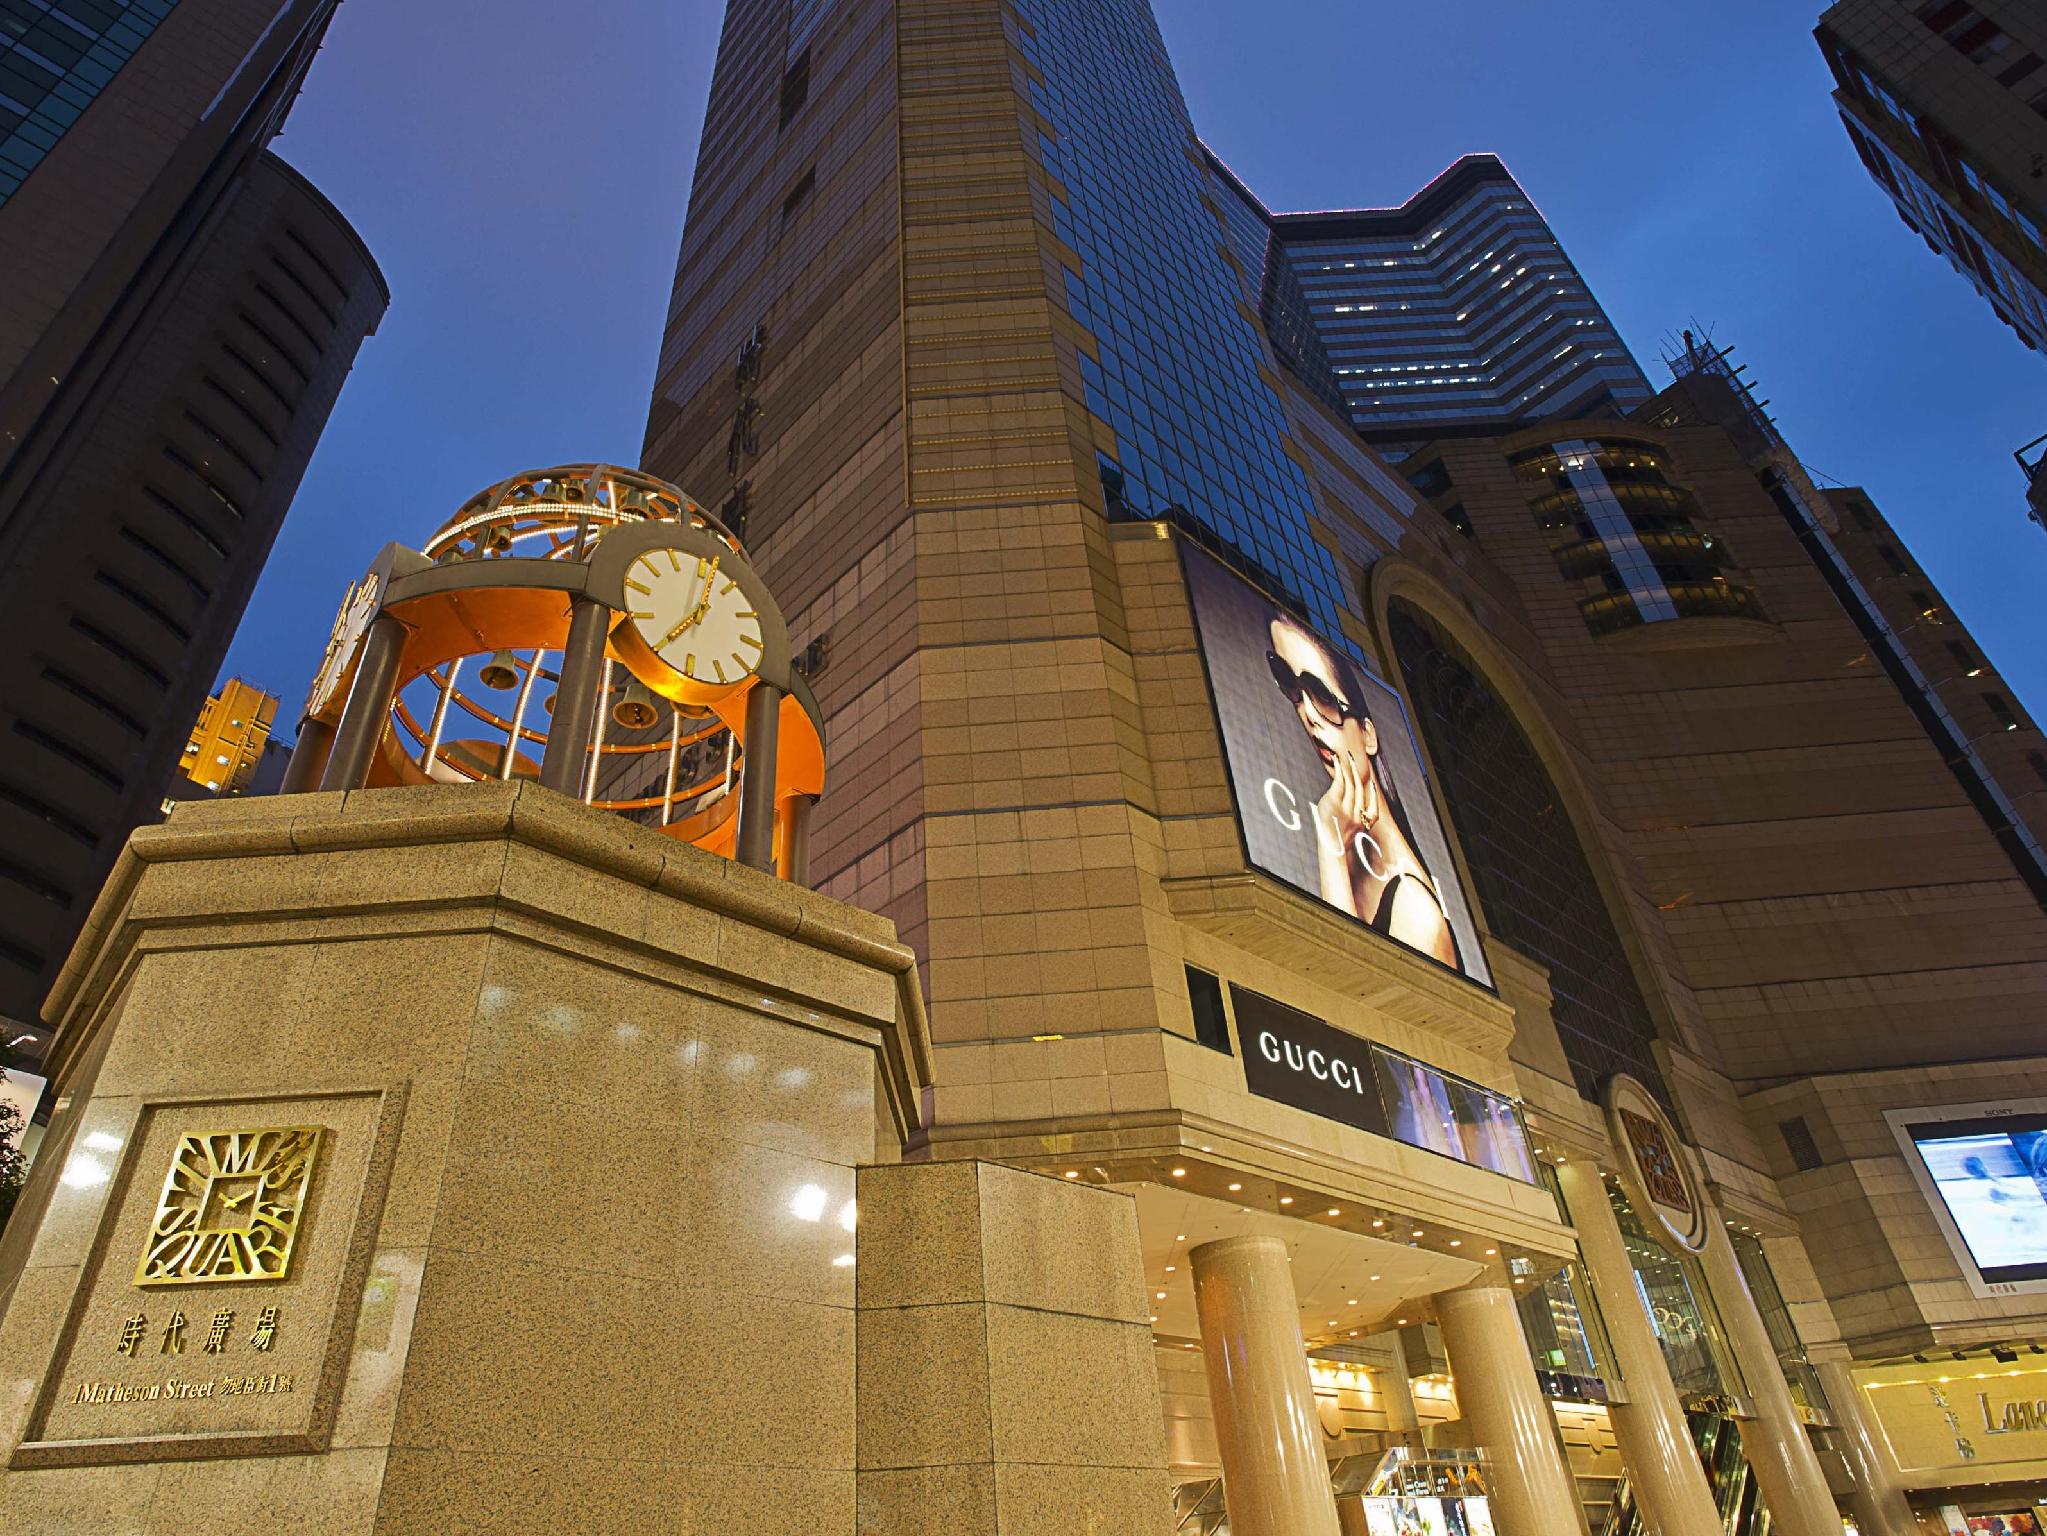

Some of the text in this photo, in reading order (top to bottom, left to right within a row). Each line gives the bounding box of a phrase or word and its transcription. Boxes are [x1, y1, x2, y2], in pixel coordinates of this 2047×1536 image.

[1260, 1031, 1364, 1094] GUCCI
[117, 1307, 277, 1357] 時代廣場
[163, 1378, 215, 1399] Street
